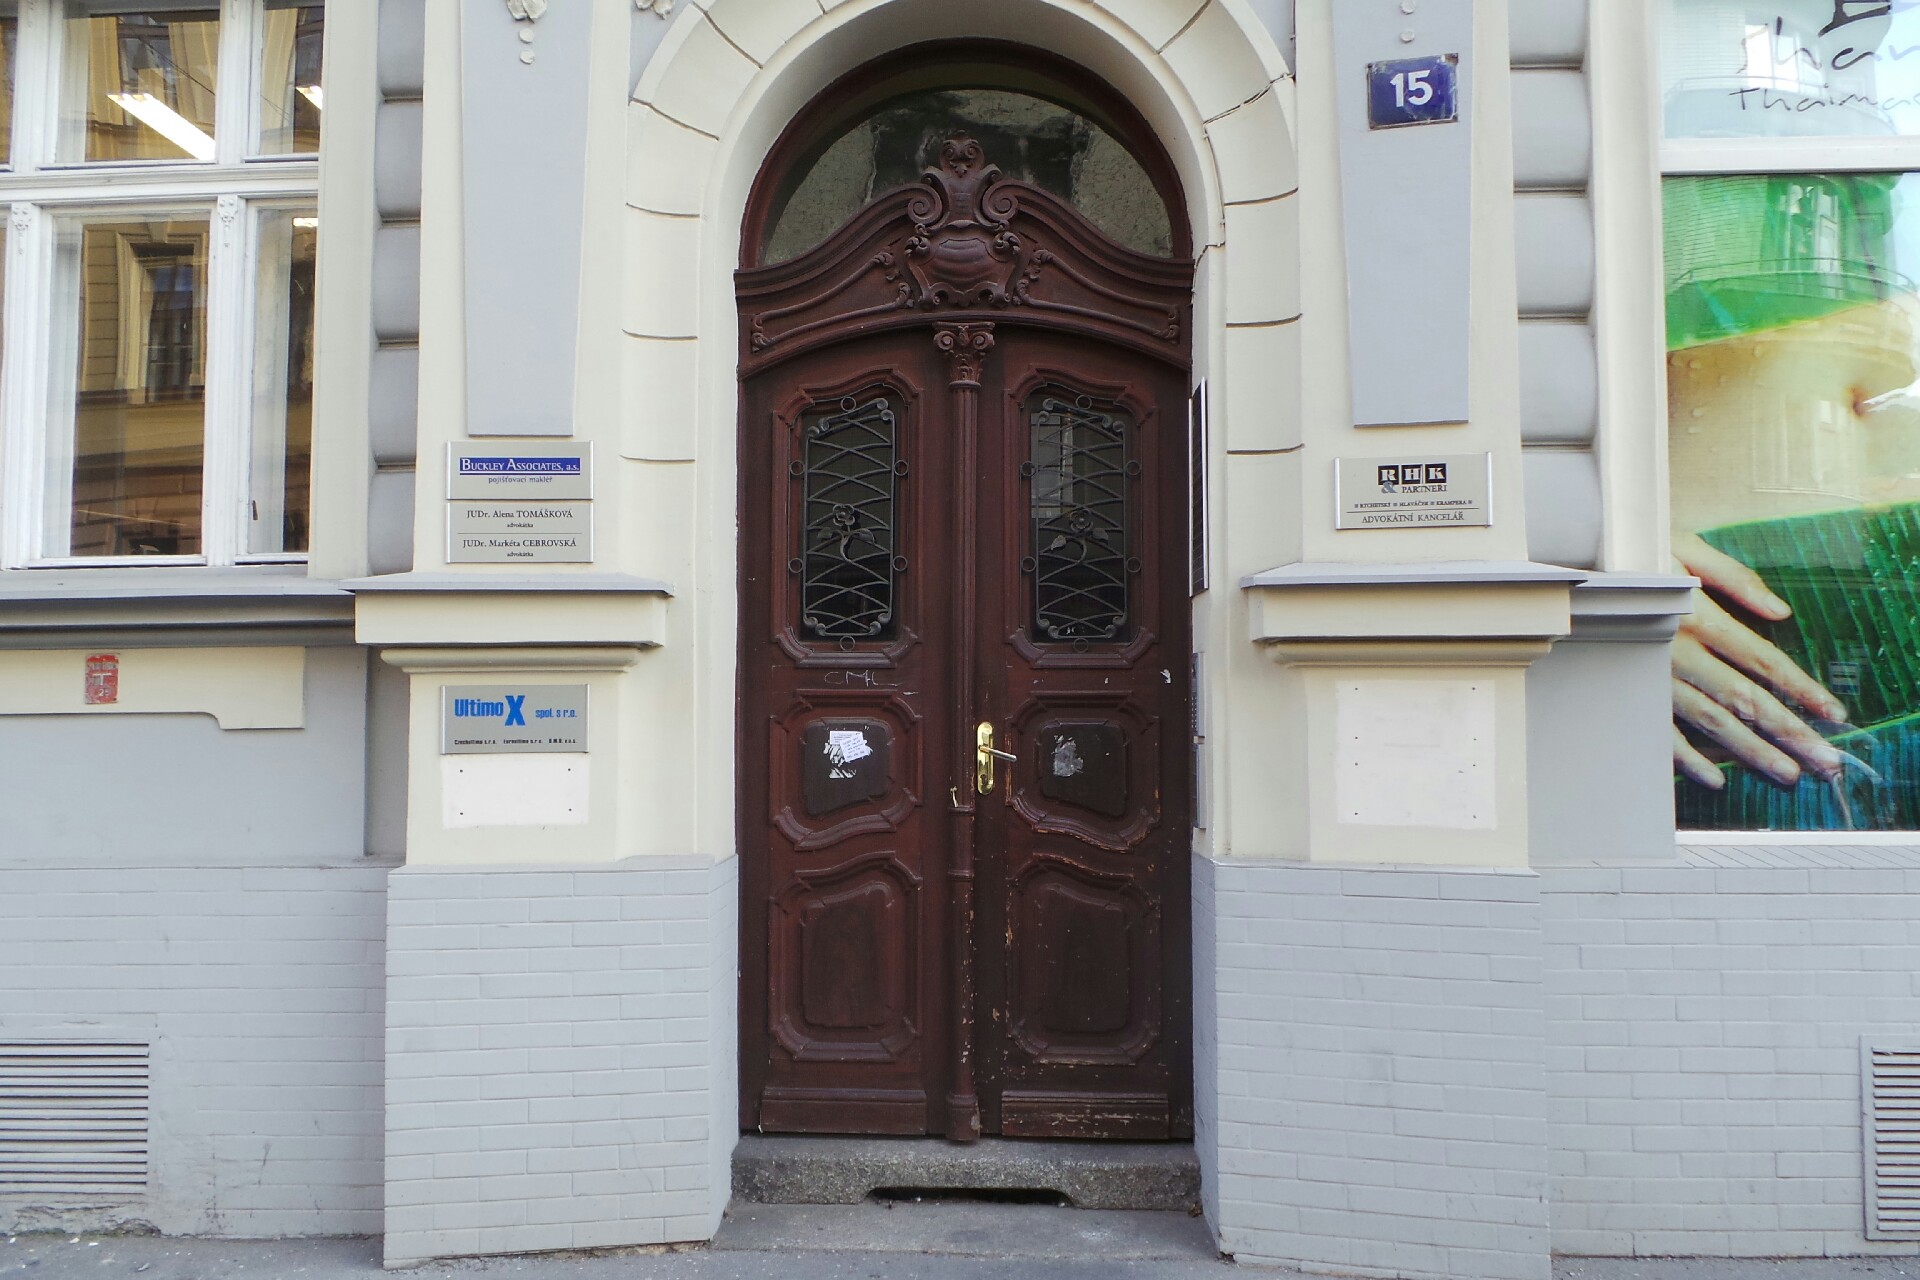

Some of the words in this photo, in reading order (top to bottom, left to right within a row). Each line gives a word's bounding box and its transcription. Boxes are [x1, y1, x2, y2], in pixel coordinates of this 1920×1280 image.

[1390, 69, 1433, 108] 15
[1380, 466, 1446, 482] RHK
[1381, 481, 1398, 494] &
[467, 510, 491, 519] JUDr.
[493, 510, 514, 518] Alena
[516, 508, 573, 518] TOMÁŠKOVÁ
[1362, 513, 1414, 524] ADVOKÁTNÍ
[1417, 511, 1465, 521] KANCELÁŘ
[463, 539, 487, 548] JUDr.
[489, 539, 520, 547] Markéta
[522, 538, 577, 547] CEBROVSKÁ
[535, 708, 554, 719] spol.
[563, 708, 578, 718] r.o.
